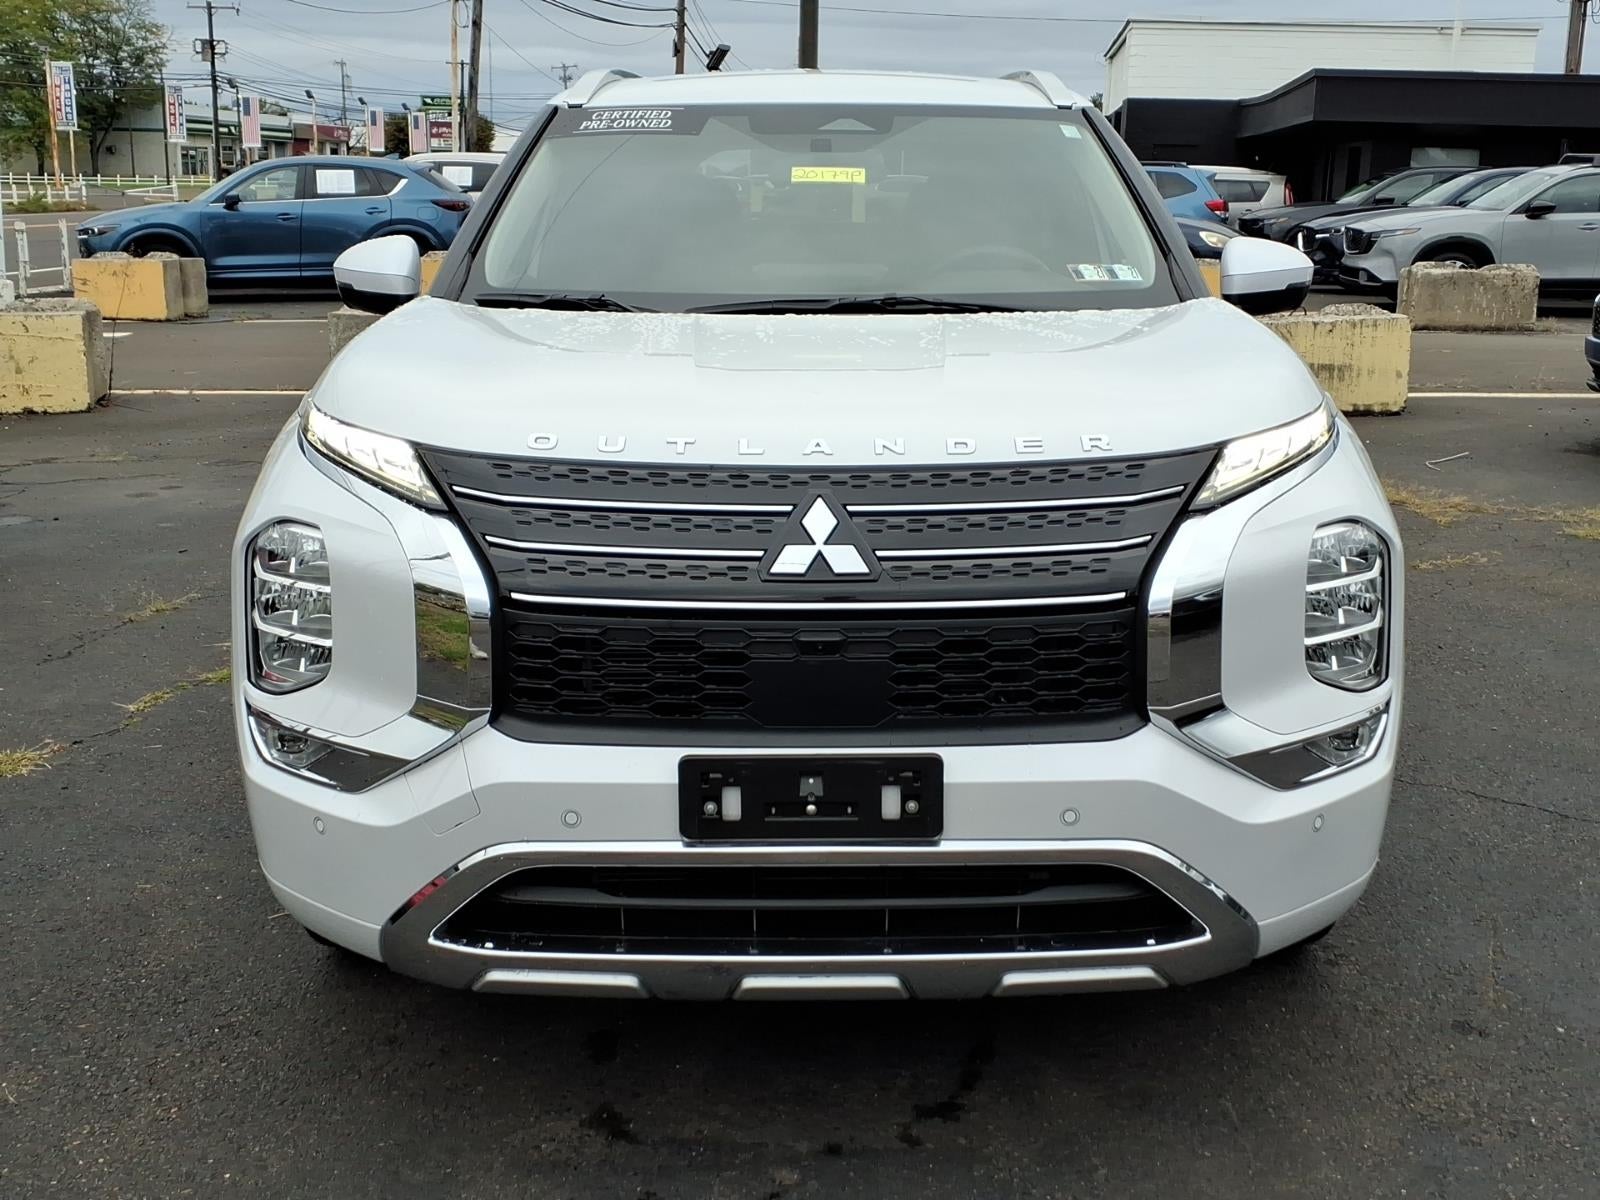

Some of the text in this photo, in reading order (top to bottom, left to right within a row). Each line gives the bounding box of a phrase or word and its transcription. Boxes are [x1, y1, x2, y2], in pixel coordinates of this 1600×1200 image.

[54, 76, 63, 120] USED
[64, 76, 73, 120] TRUCKS
[168, 95, 176, 134] USED
[579, 119, 672, 130] PRE-OWNED
[591, 110, 672, 120] CERTIFIED
[526, 432, 1113, 456] OUTLANDER
